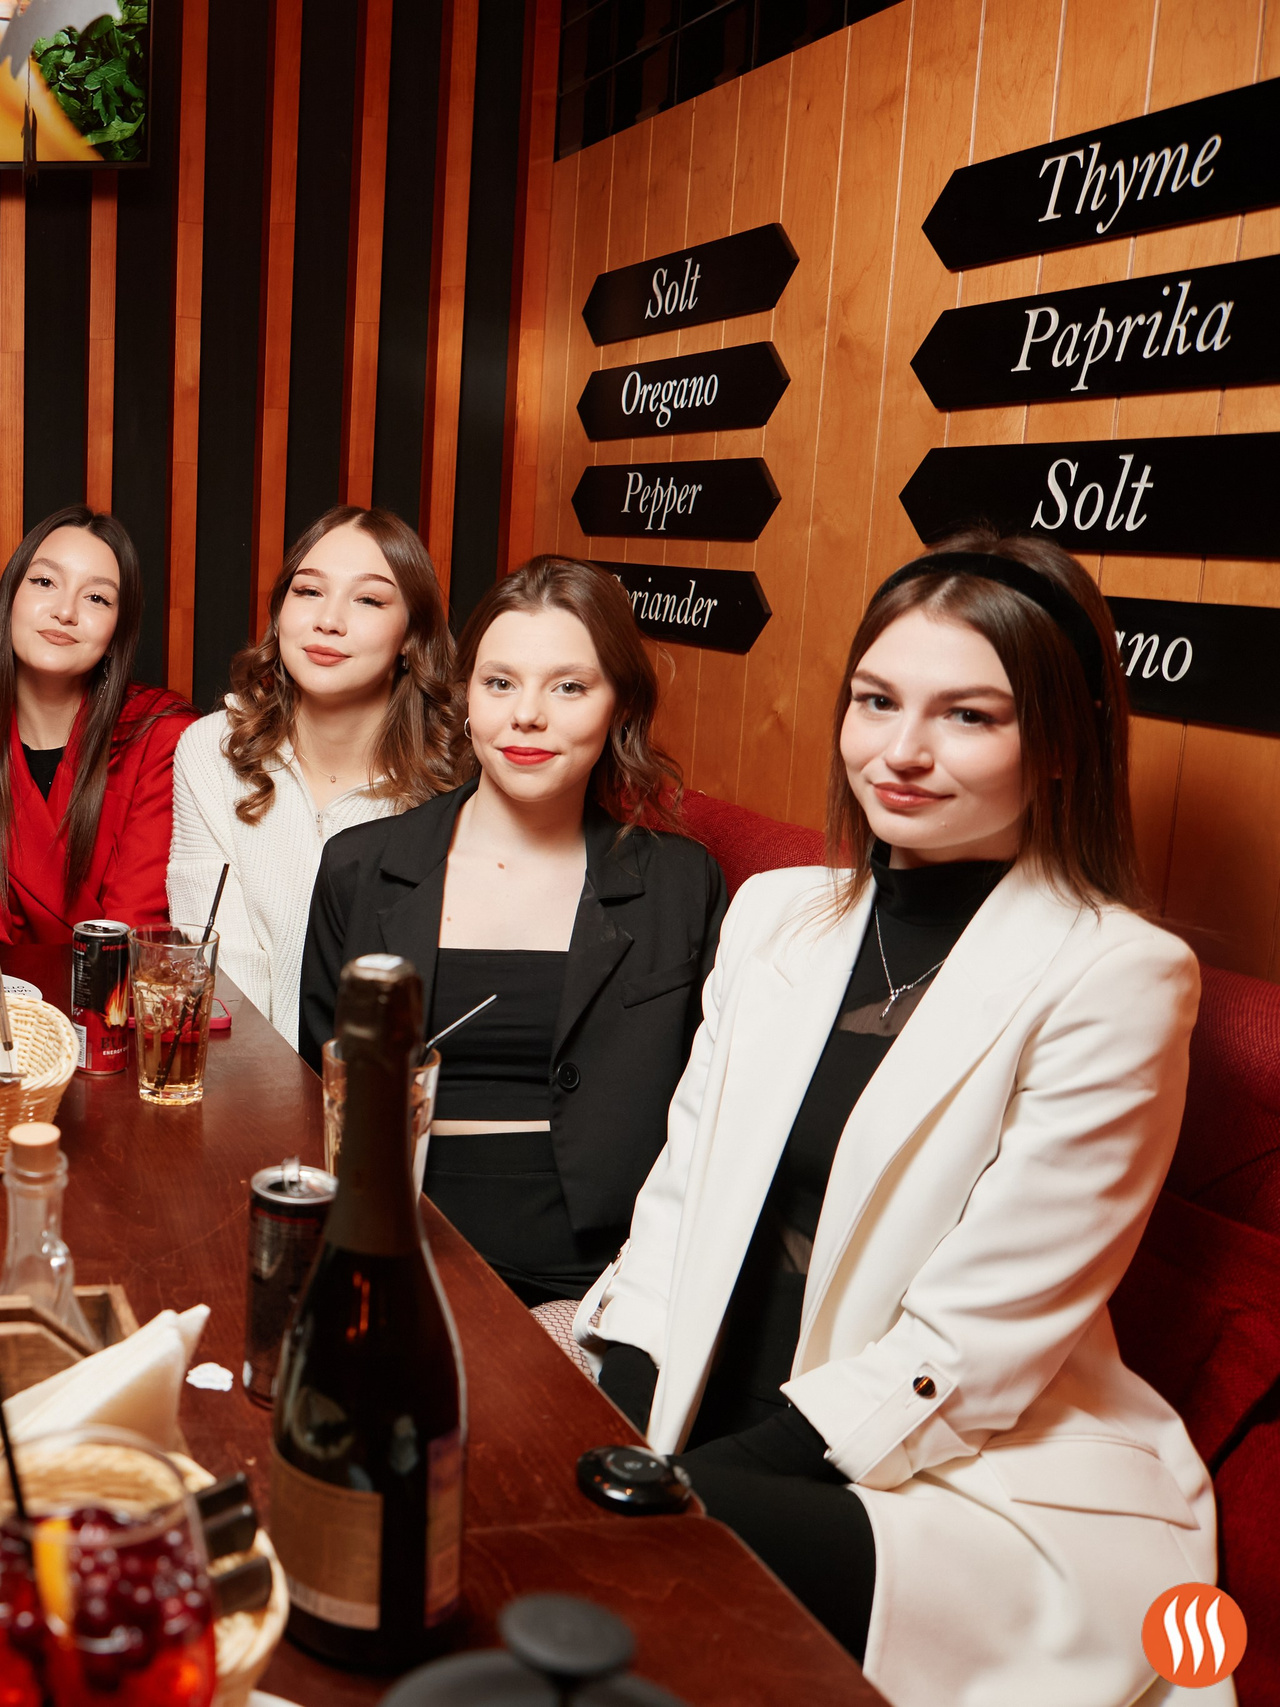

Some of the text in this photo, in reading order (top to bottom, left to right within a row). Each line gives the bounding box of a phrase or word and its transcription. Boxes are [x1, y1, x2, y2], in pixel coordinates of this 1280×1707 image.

[1038, 133, 1223, 234] Thyme
[645, 258, 701, 320] Solt
[1011, 280, 1234, 392] Paprika
[621, 372, 719, 428] Oregano
[621, 472, 703, 531] Pepper
[1031, 454, 1154, 532] Solt
[613, 574, 718, 628] riander
